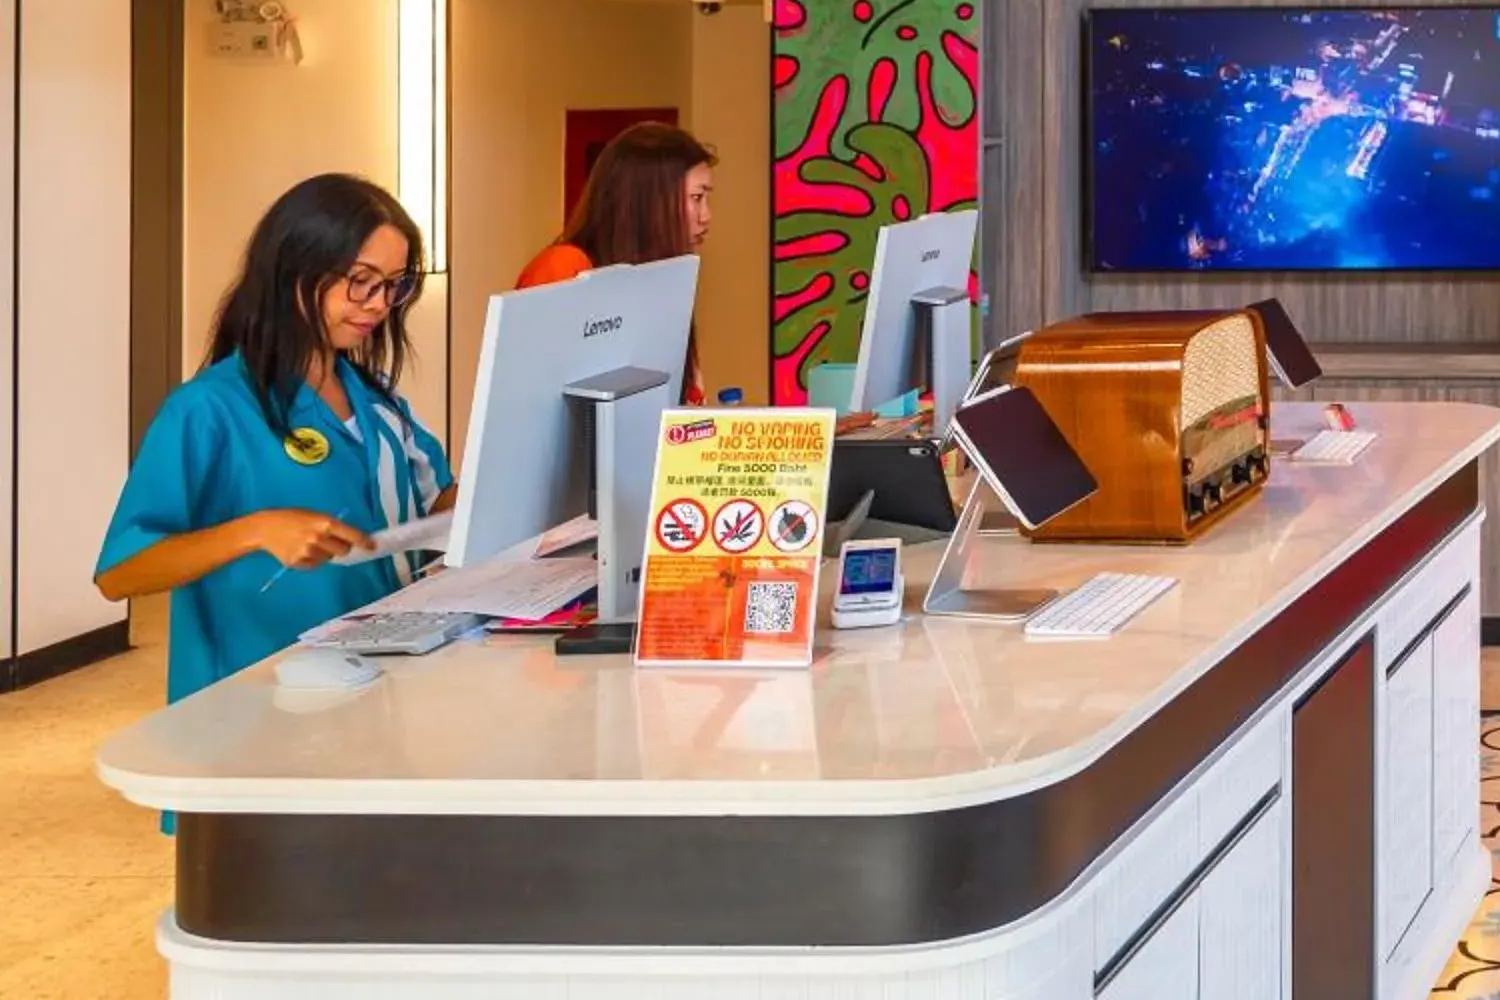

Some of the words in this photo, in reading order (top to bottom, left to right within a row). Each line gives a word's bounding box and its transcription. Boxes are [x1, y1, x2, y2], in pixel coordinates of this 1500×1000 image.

[583, 315, 623, 338] Lenovo
[731, 421, 755, 434] NO
[717, 437, 742, 450] NO
